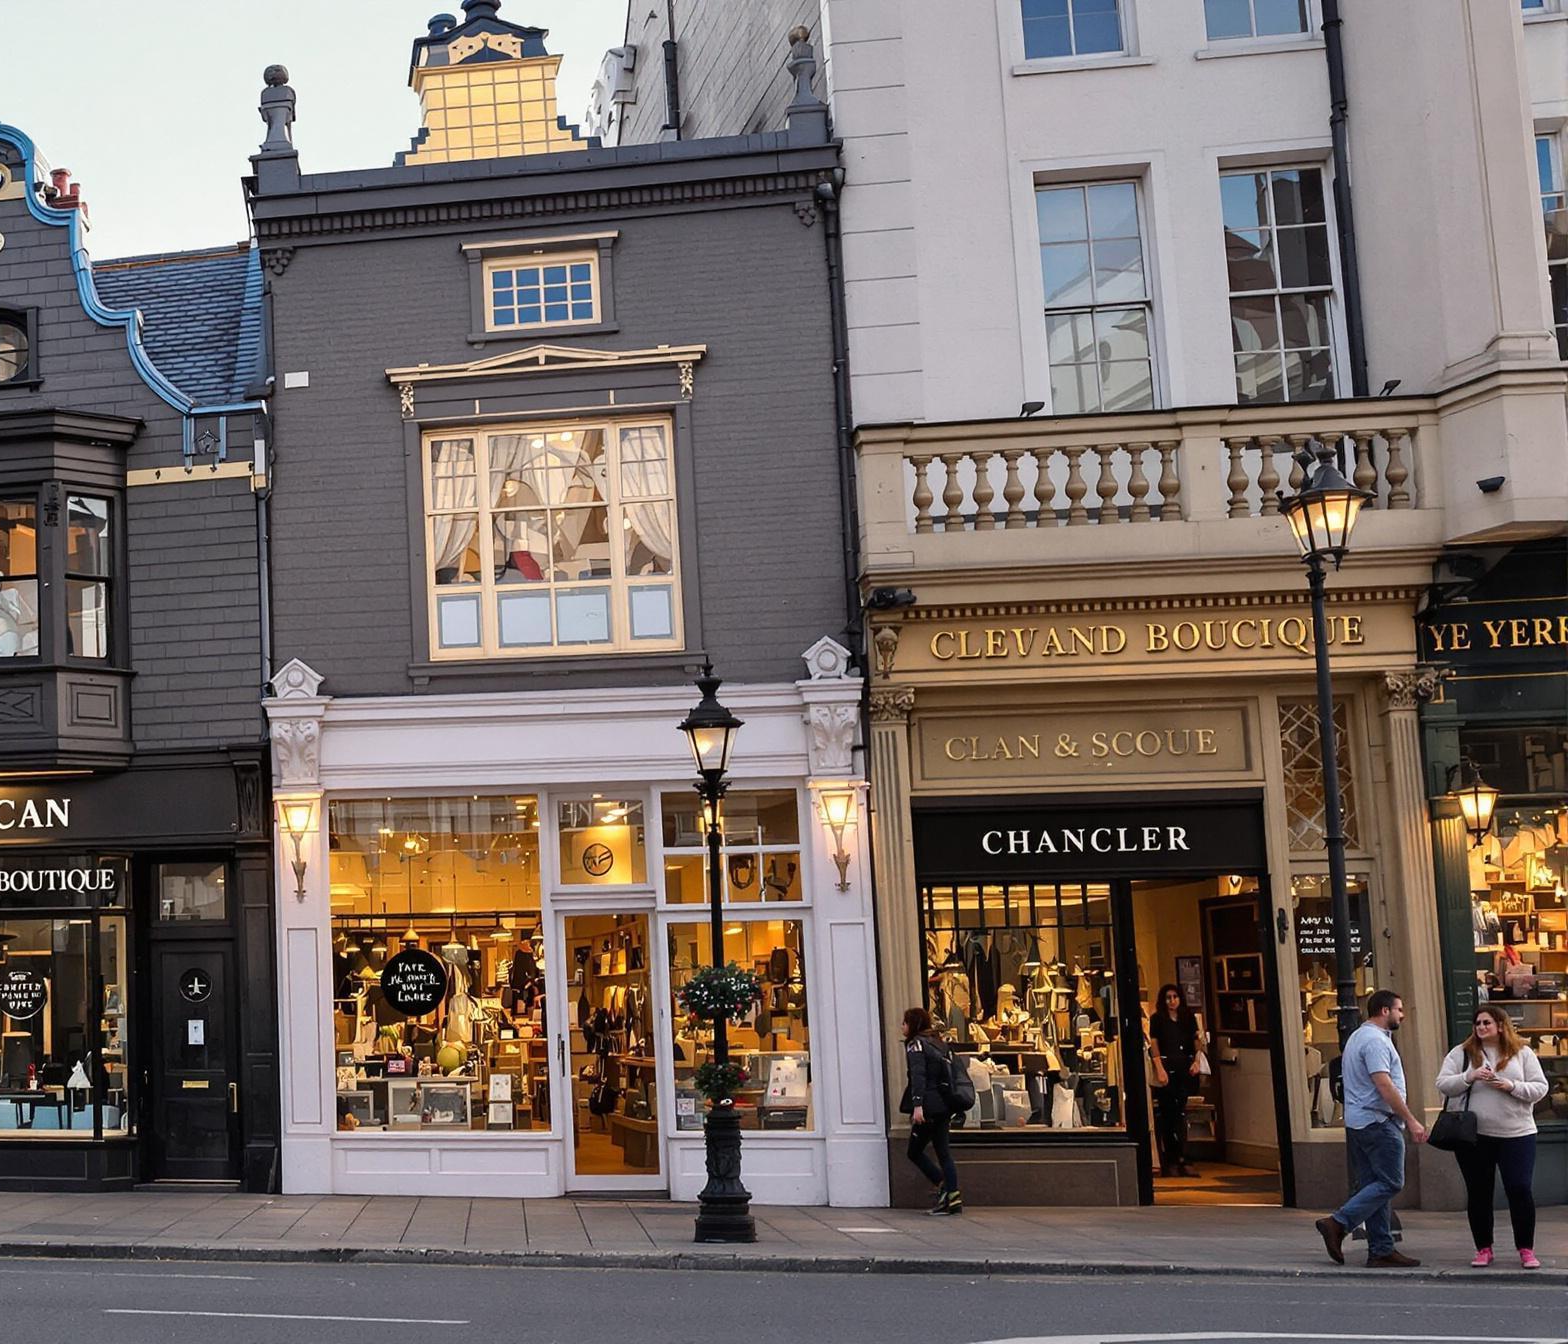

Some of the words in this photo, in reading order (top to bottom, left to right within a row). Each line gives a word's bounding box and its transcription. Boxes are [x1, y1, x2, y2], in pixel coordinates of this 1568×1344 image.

[930, 624, 1127, 660] CLEVAND
[1428, 622, 1471, 651] YE
[944, 734, 1041, 761] CLAN
[1054, 733, 1080, 757] &
[1091, 728, 1219, 758] SCOUE
[982, 826, 1190, 854] CHANCLER
